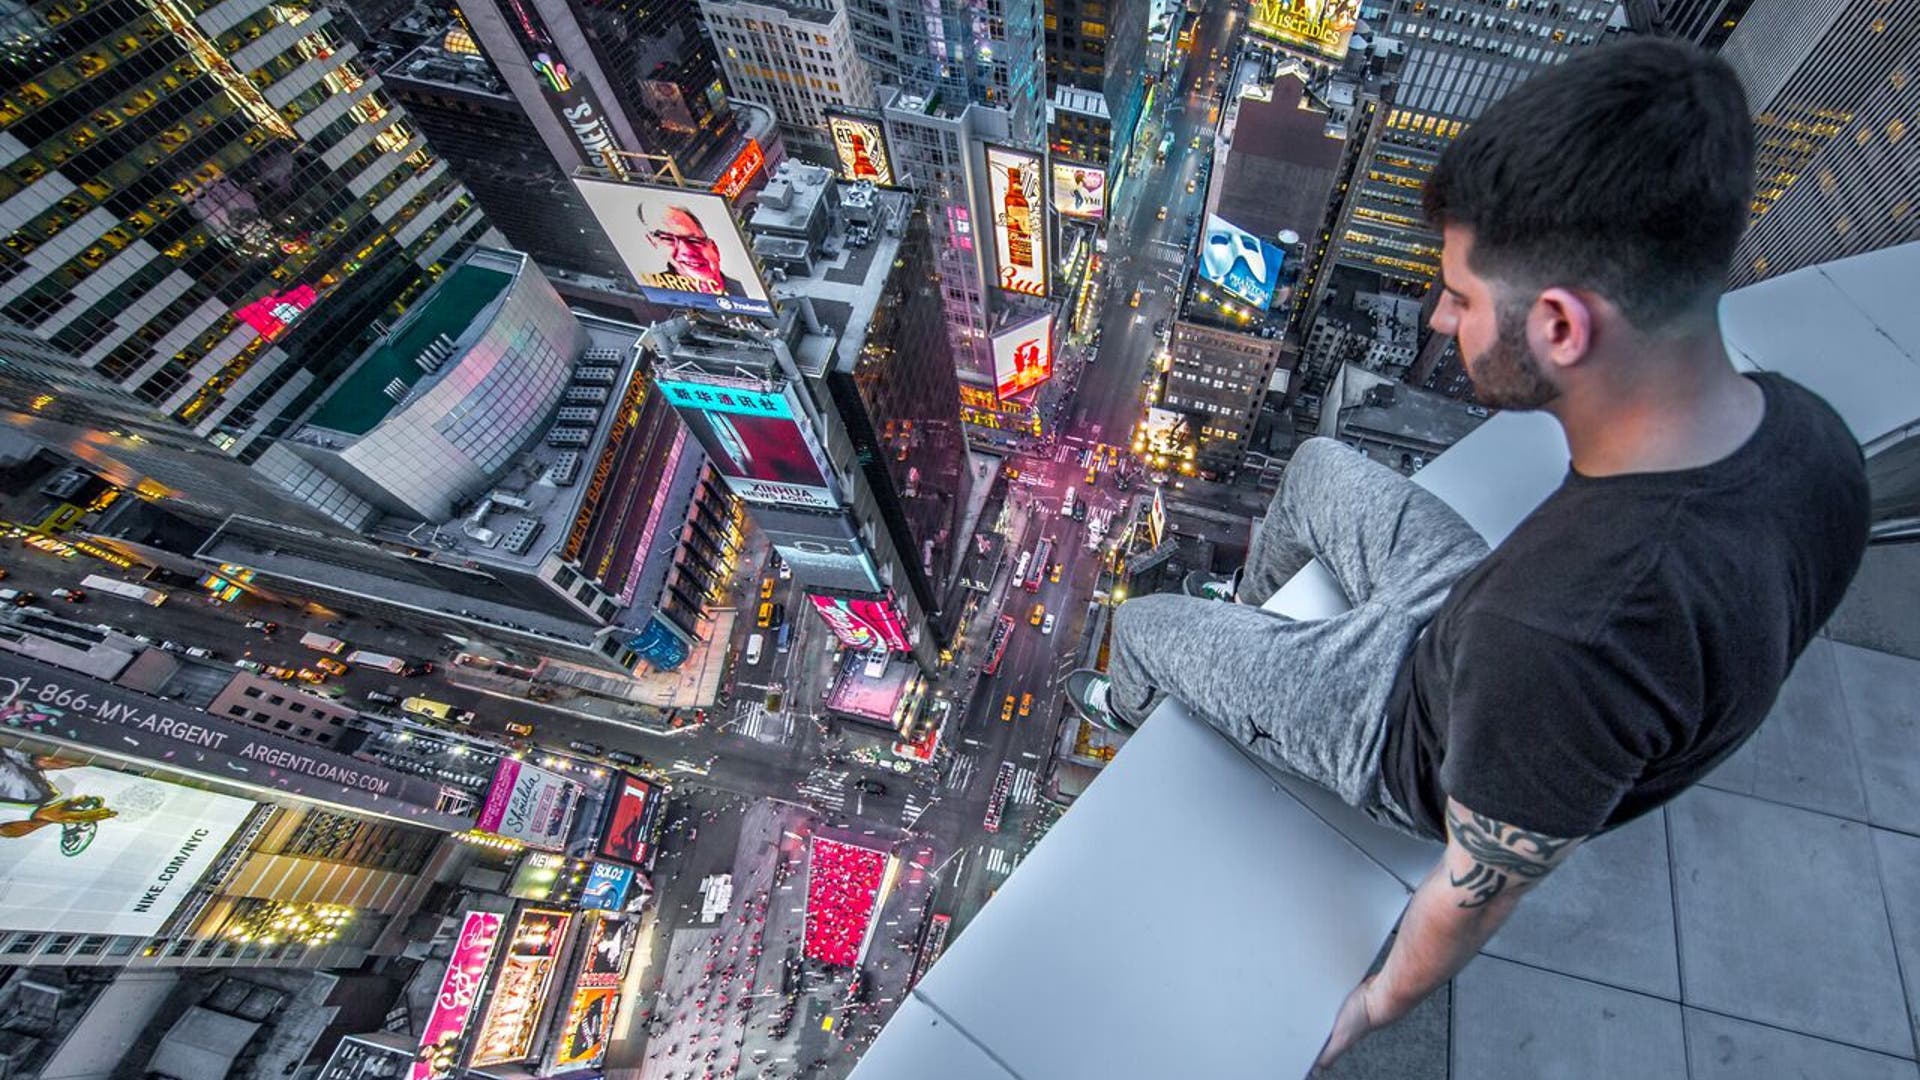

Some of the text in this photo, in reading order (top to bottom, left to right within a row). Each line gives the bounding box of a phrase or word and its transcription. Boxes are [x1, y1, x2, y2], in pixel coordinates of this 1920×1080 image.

[741, 489, 829, 506] NEWS AGENCY
[750, 483, 813, 498] XINHUA
[18, 676, 228, 749] 1-866-MY-ARGENT
[239, 742, 390, 793] ARGENTLOANS.COM
[506, 773, 541, 833] Shoulda
[132, 828, 209, 913] NIKE.COM/NYC
